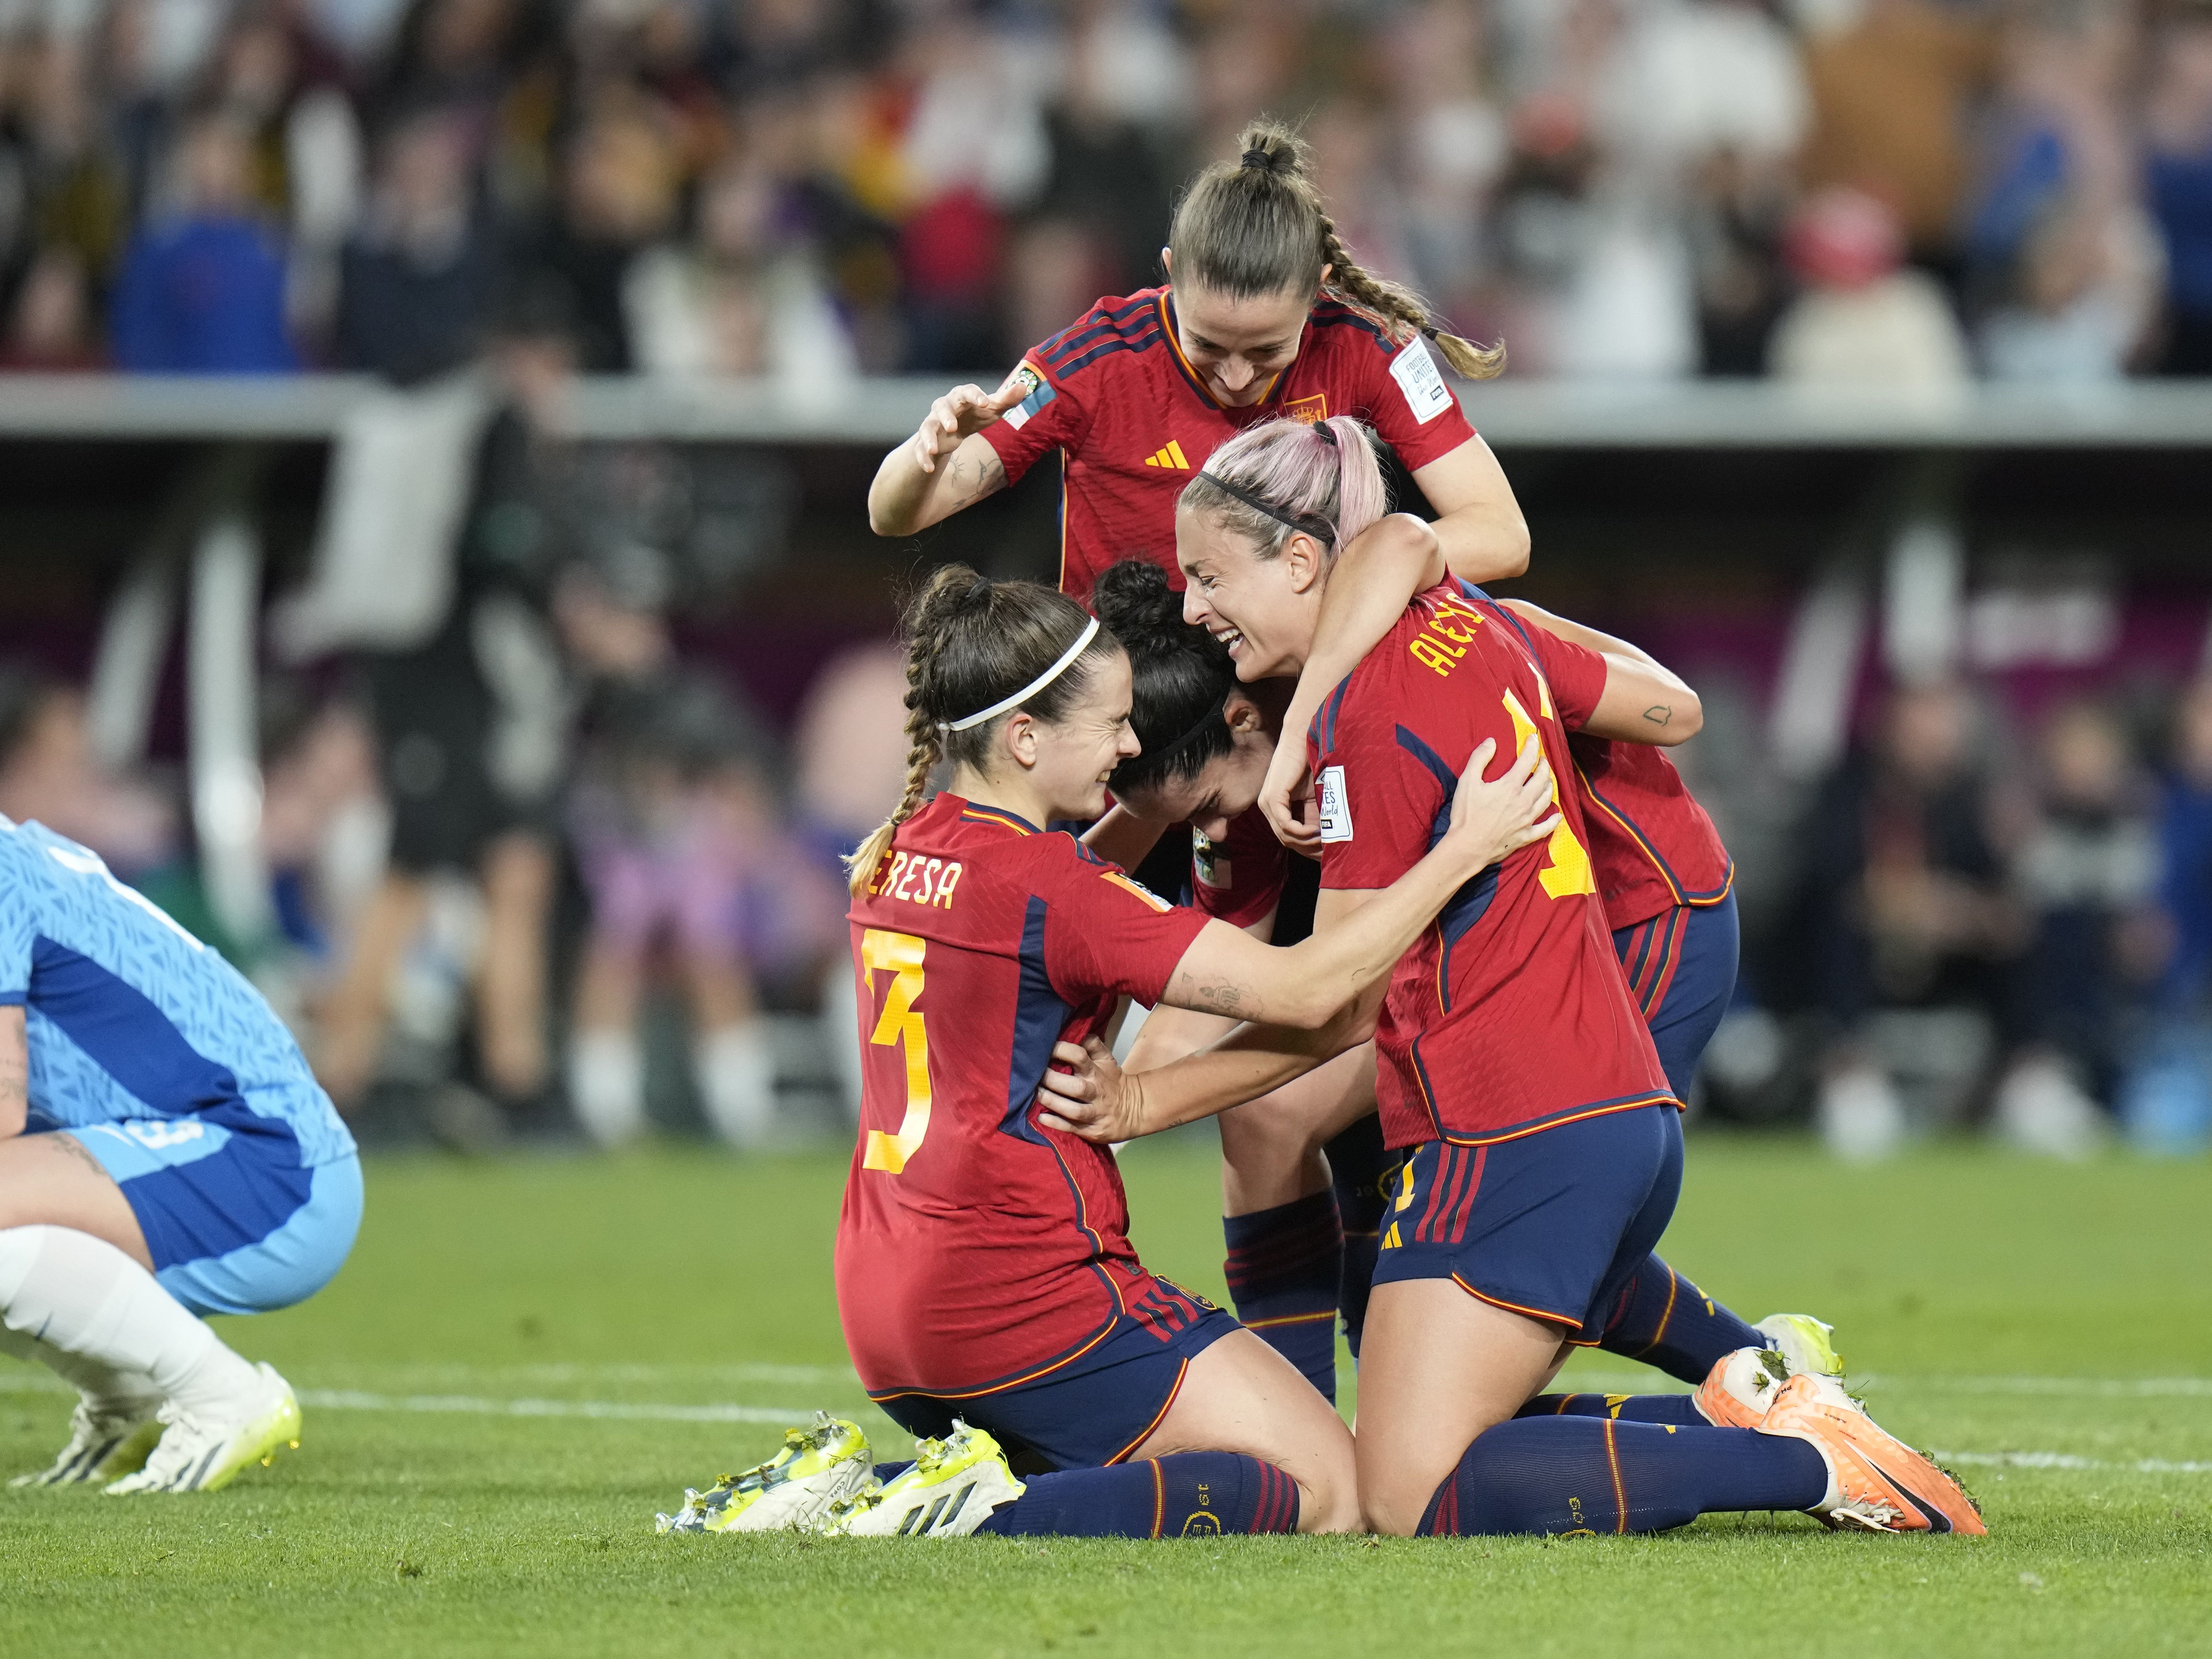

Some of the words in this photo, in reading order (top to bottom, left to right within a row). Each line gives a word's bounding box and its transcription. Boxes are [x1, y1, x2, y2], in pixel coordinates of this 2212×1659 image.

[868, 849, 963, 909] ERESA
[861, 928, 932, 1175] 3
[829, 1481, 845, 1498] COPA
